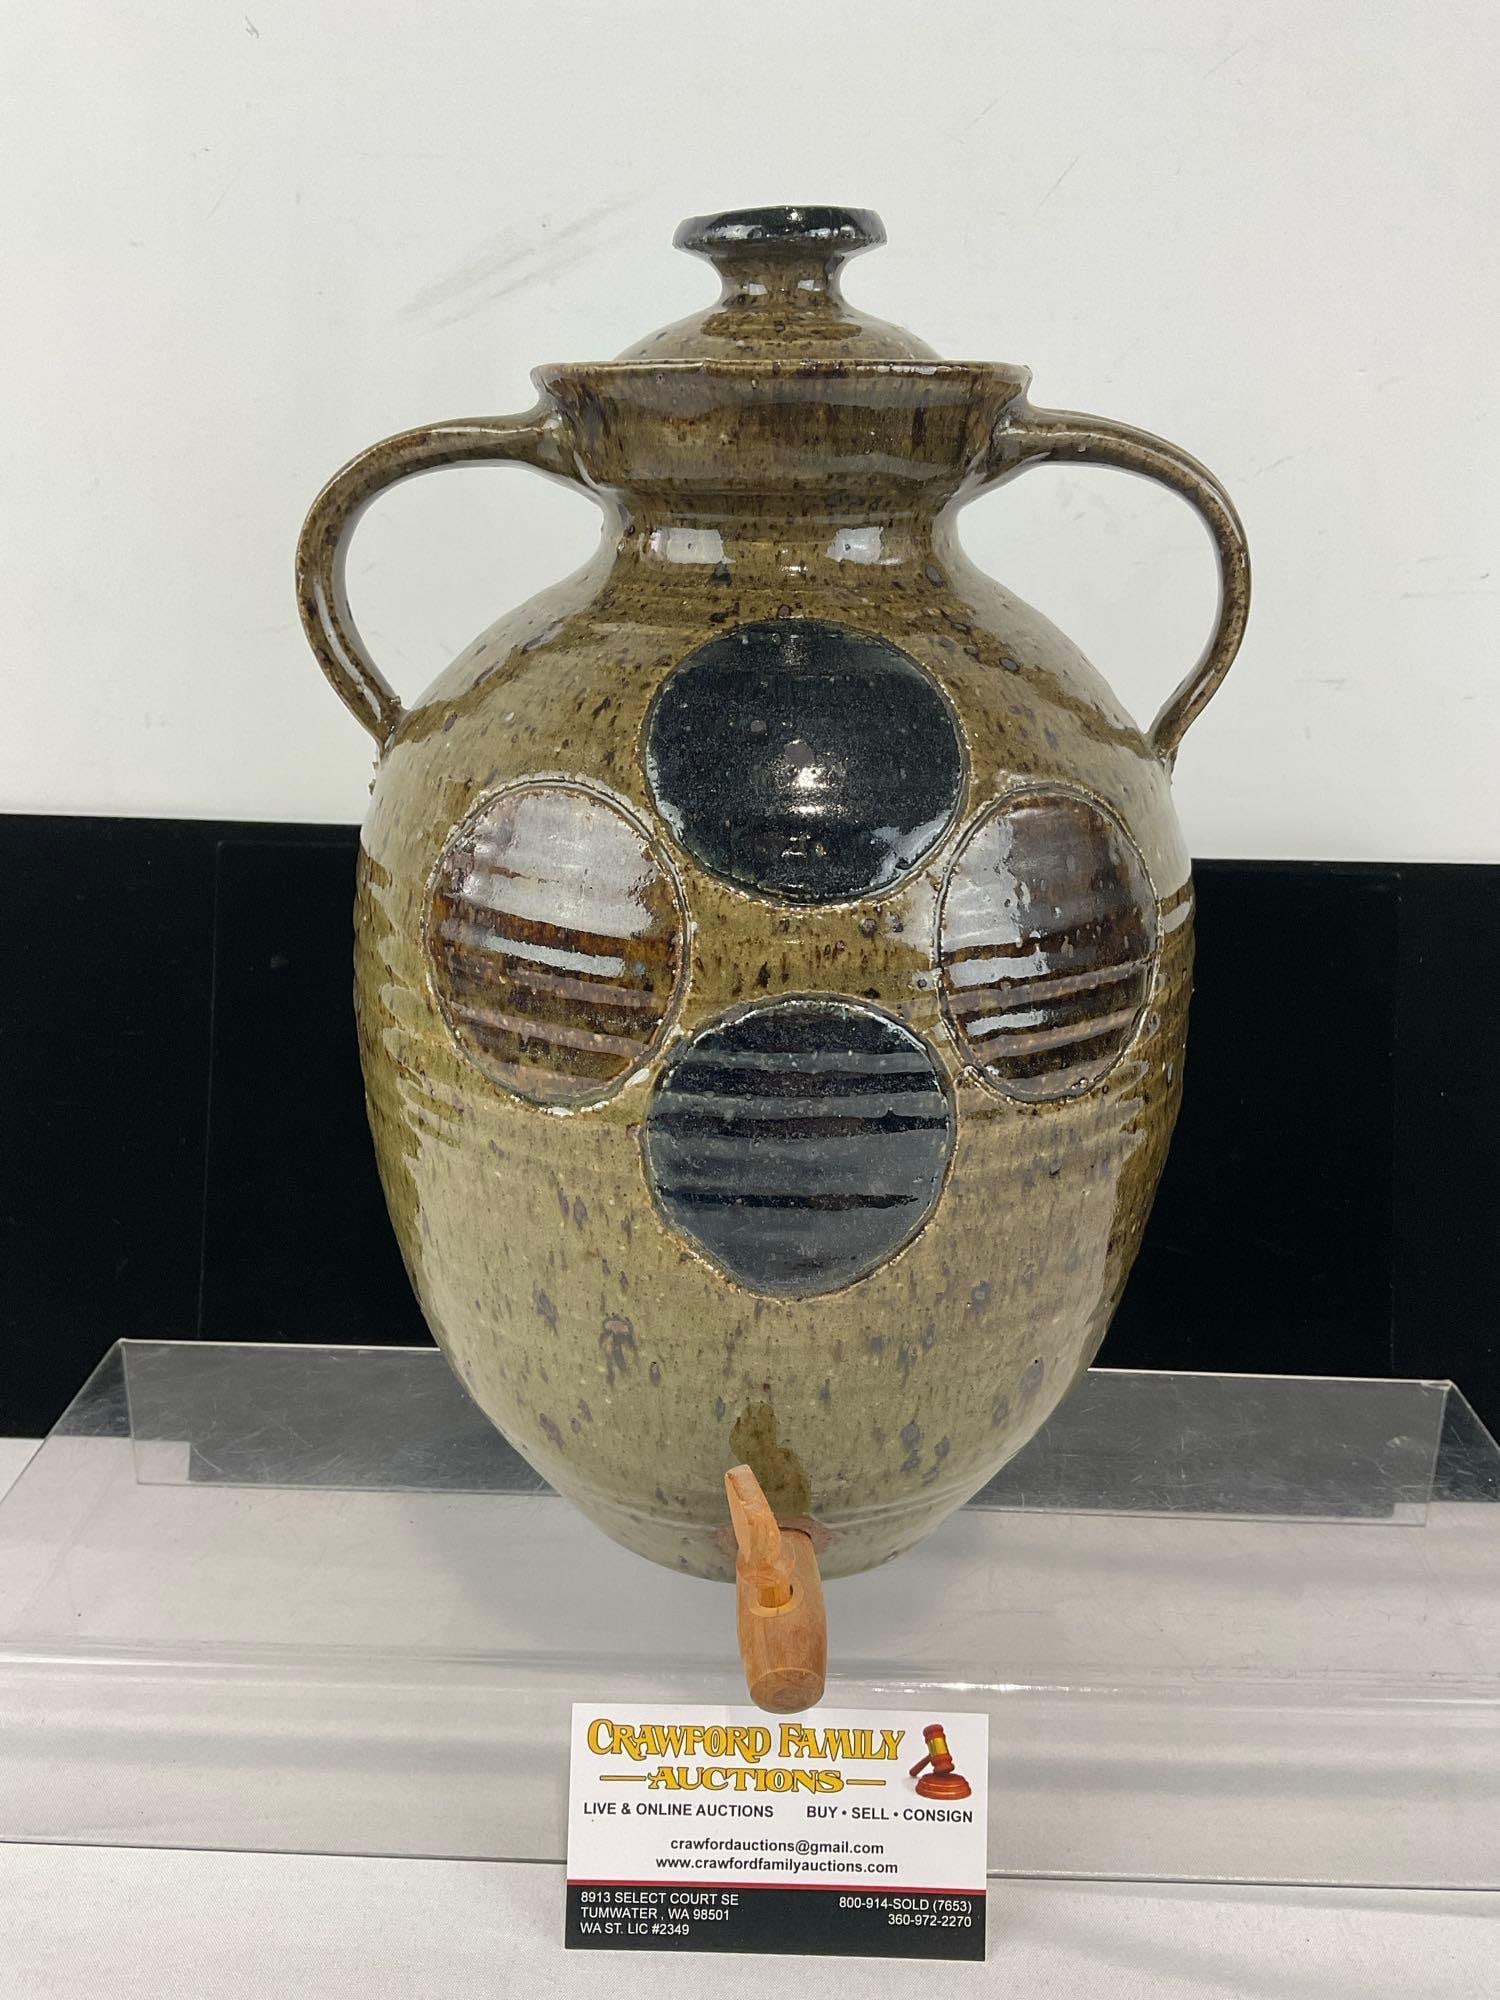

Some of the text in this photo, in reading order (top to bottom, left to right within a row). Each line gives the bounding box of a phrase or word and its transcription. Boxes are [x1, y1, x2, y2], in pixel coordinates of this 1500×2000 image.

[588, 1719, 904, 1763] CRAWFORD FAMILY
[648, 1767, 844, 1793] AUCTIONS
[584, 1803, 773, 1818] LIVE & ONLINE AUCTIONS
[807, 1807, 973, 1823] BUY SELL CONSIGN
[671, 1838, 883, 1856] crawfordauctions@gmail.com
[656, 1856, 898, 1875] www.crawfordfamilyauctions.com
[581, 1892, 738, 1906] 8913 SELECT COURT SE
[839, 1897, 972, 1913] 800-914-SOLD (7653)
[668, 1909, 690, 1920] WA
[693, 1909, 729, 1921] 98501
[888, 1914, 971, 1928] 360-972-2270
[580, 1923, 689, 1935] WA ST. LIC #2349
